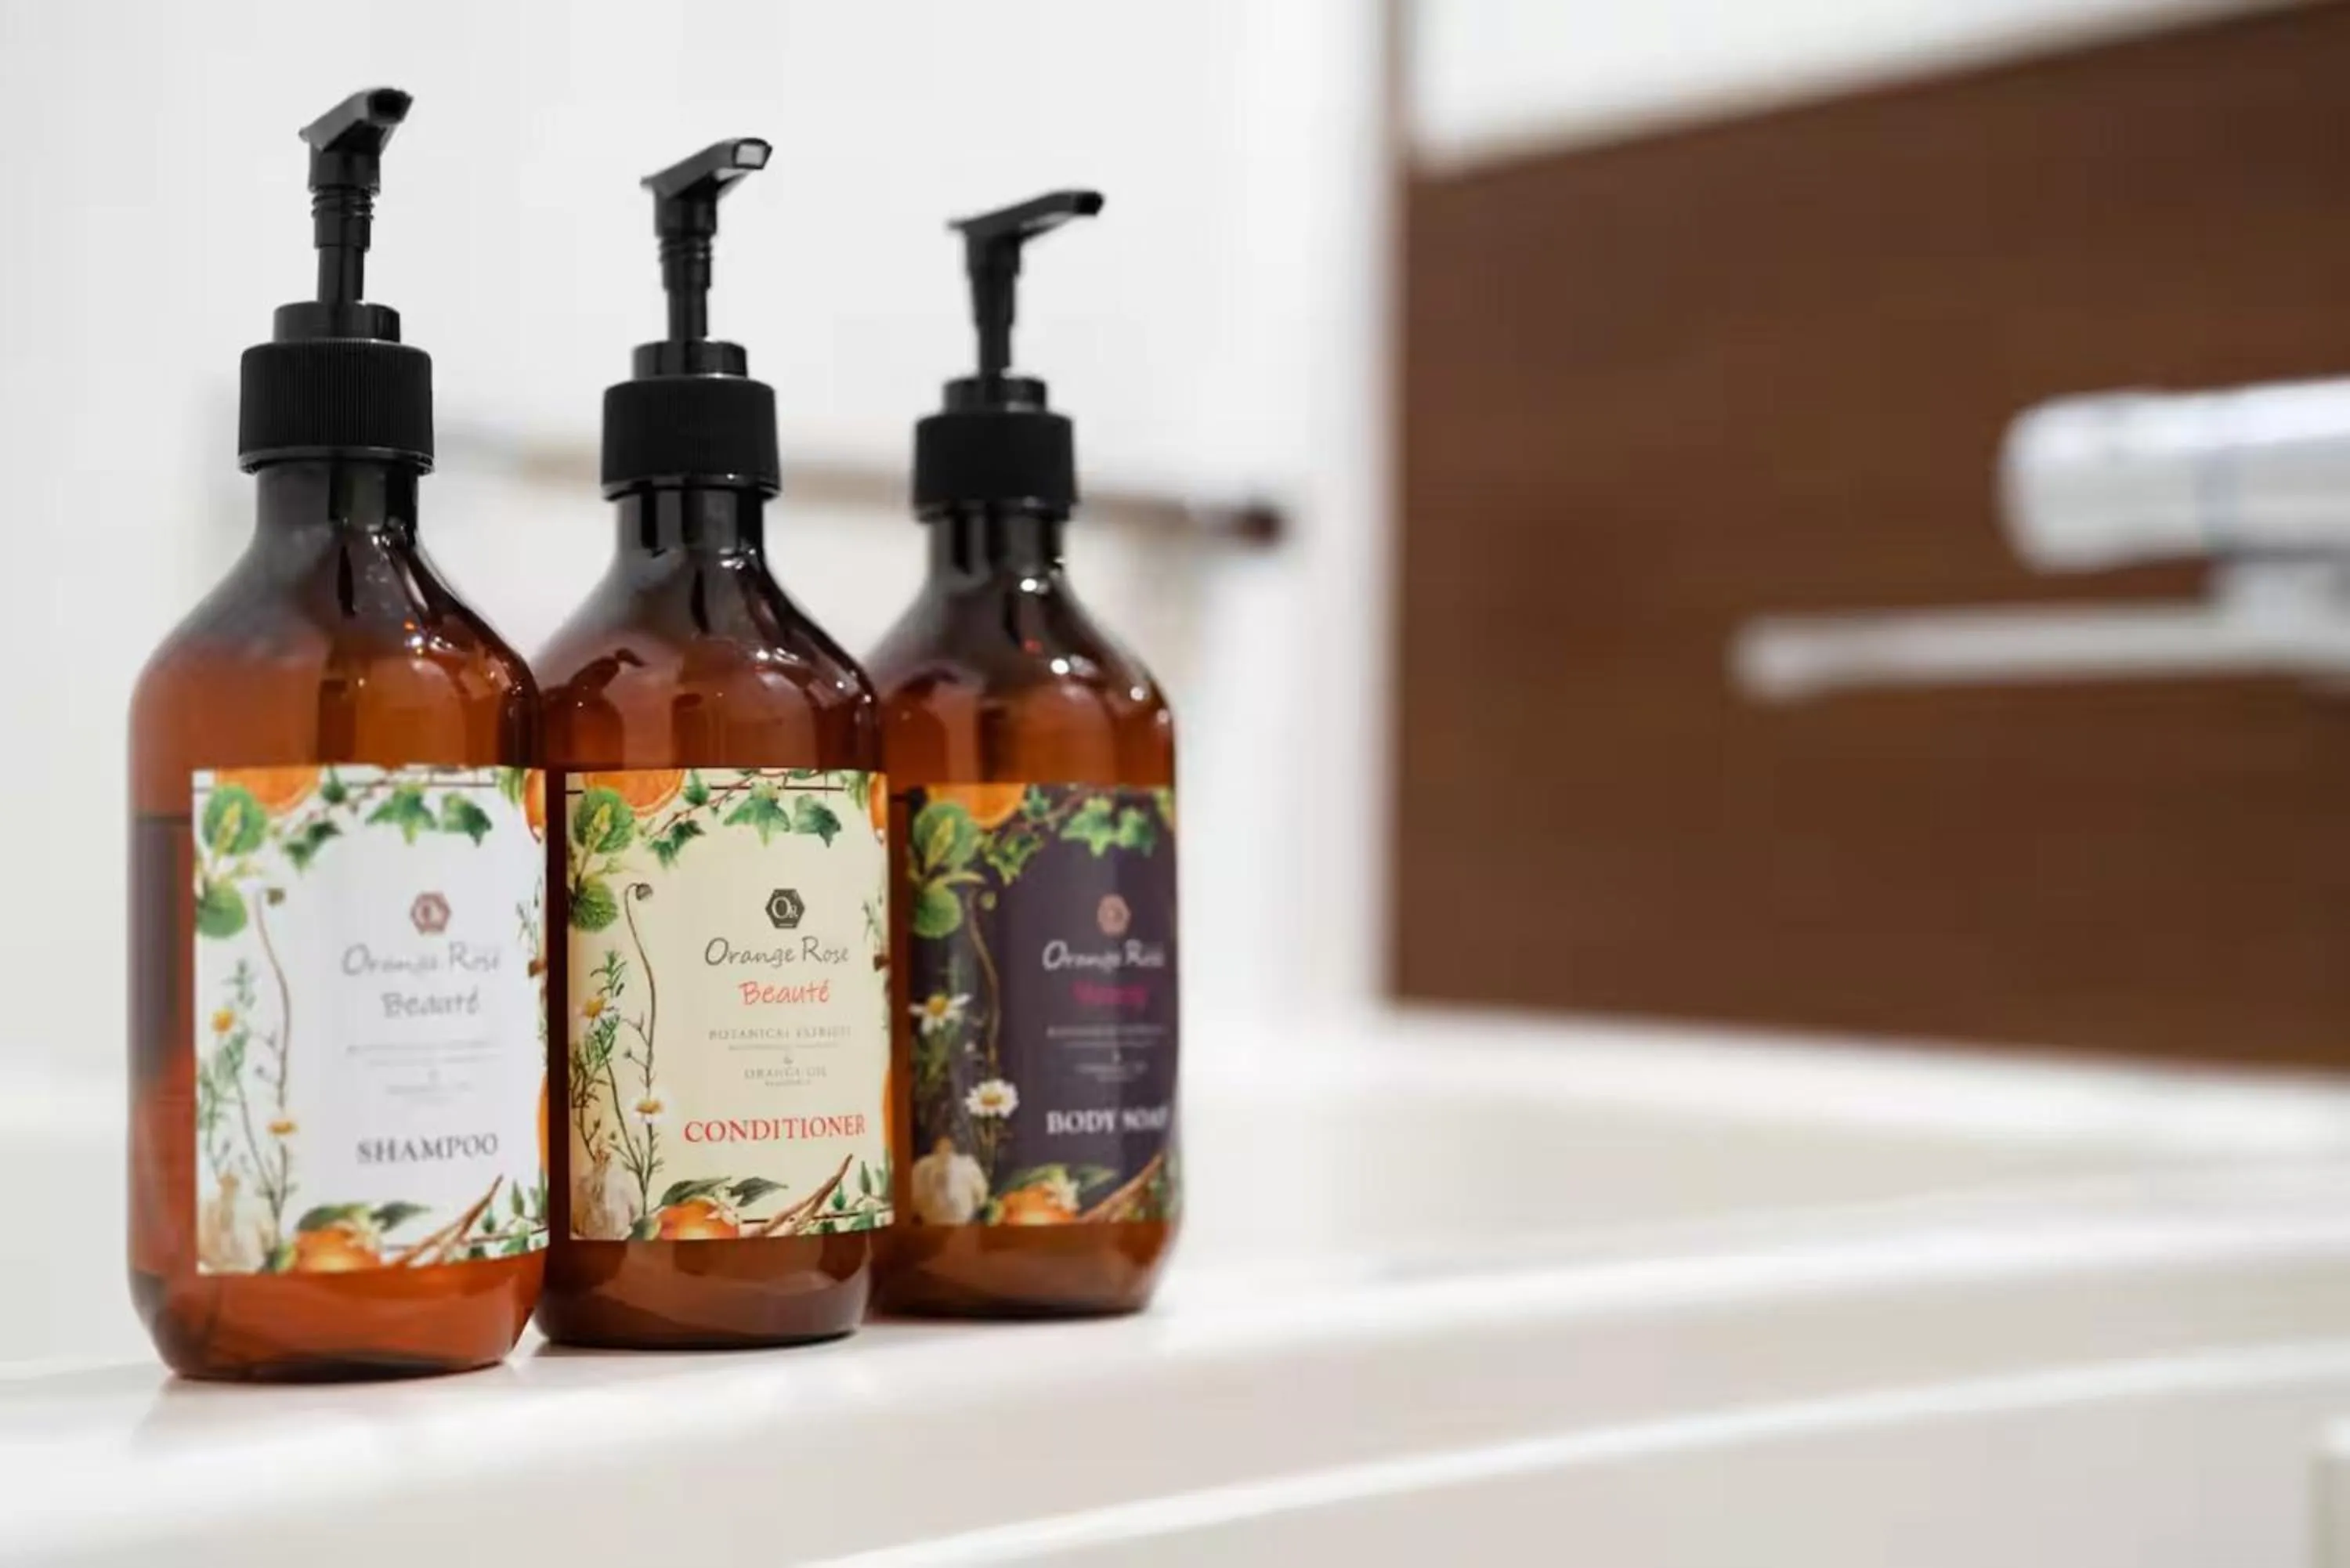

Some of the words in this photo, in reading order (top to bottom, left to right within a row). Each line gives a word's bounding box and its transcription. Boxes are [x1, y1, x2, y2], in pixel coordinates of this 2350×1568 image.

[705, 937, 797, 969] Orange
[801, 935, 850, 965] Rose
[738, 979, 830, 1006] Beauté
[684, 1115, 866, 1143] CONDITIONER
[1045, 1109, 1115, 1136] BODY
[356, 1133, 499, 1164] SHAMPOO
